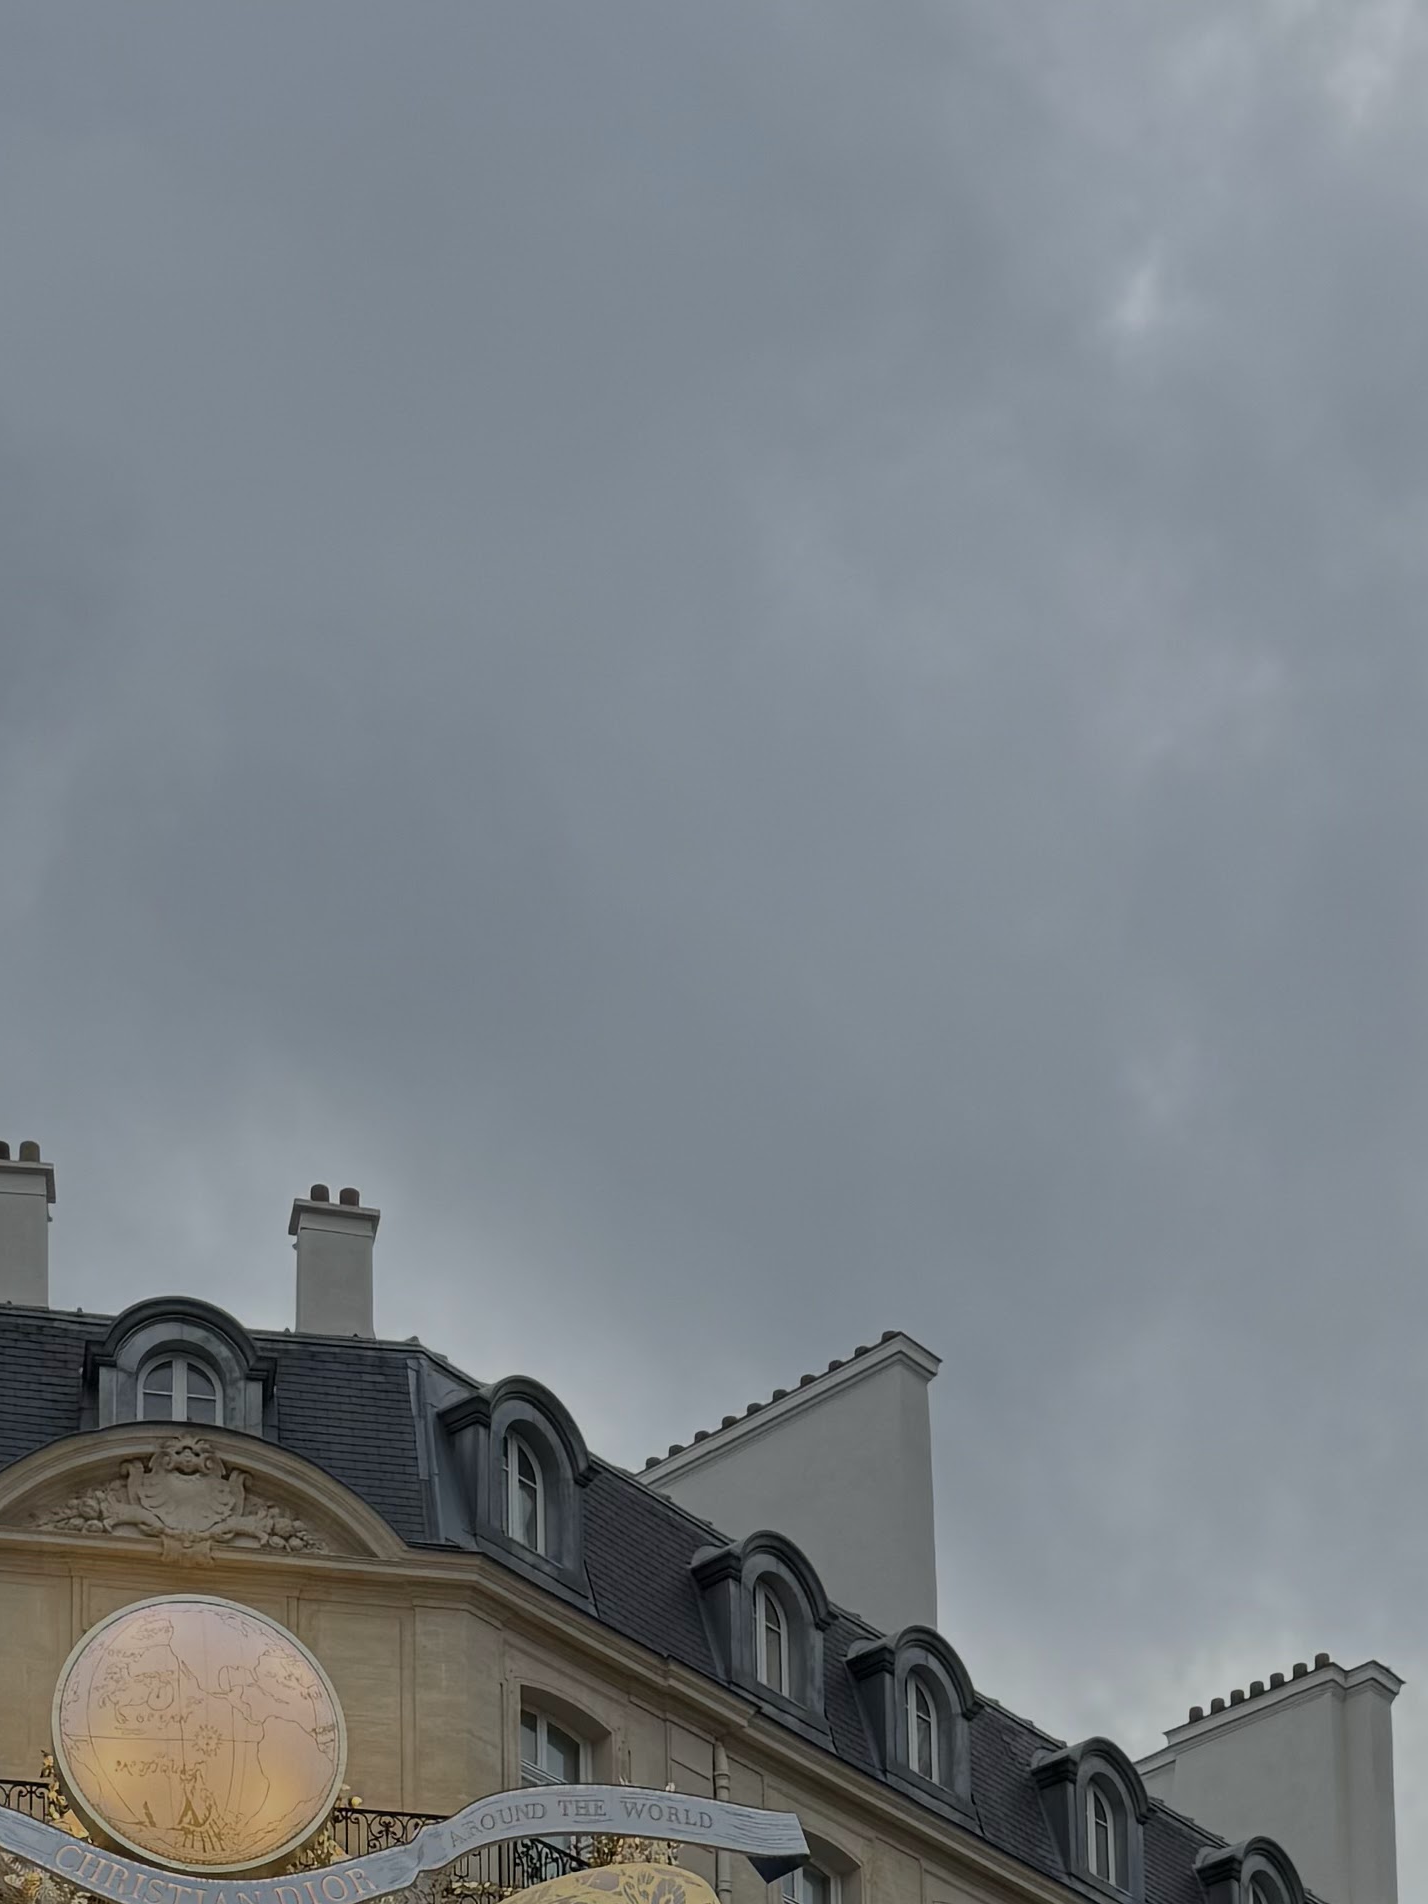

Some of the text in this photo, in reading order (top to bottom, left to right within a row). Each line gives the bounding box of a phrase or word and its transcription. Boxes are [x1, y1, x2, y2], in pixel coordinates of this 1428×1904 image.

[450, 1799, 714, 1848] AROUND THE WORLD
